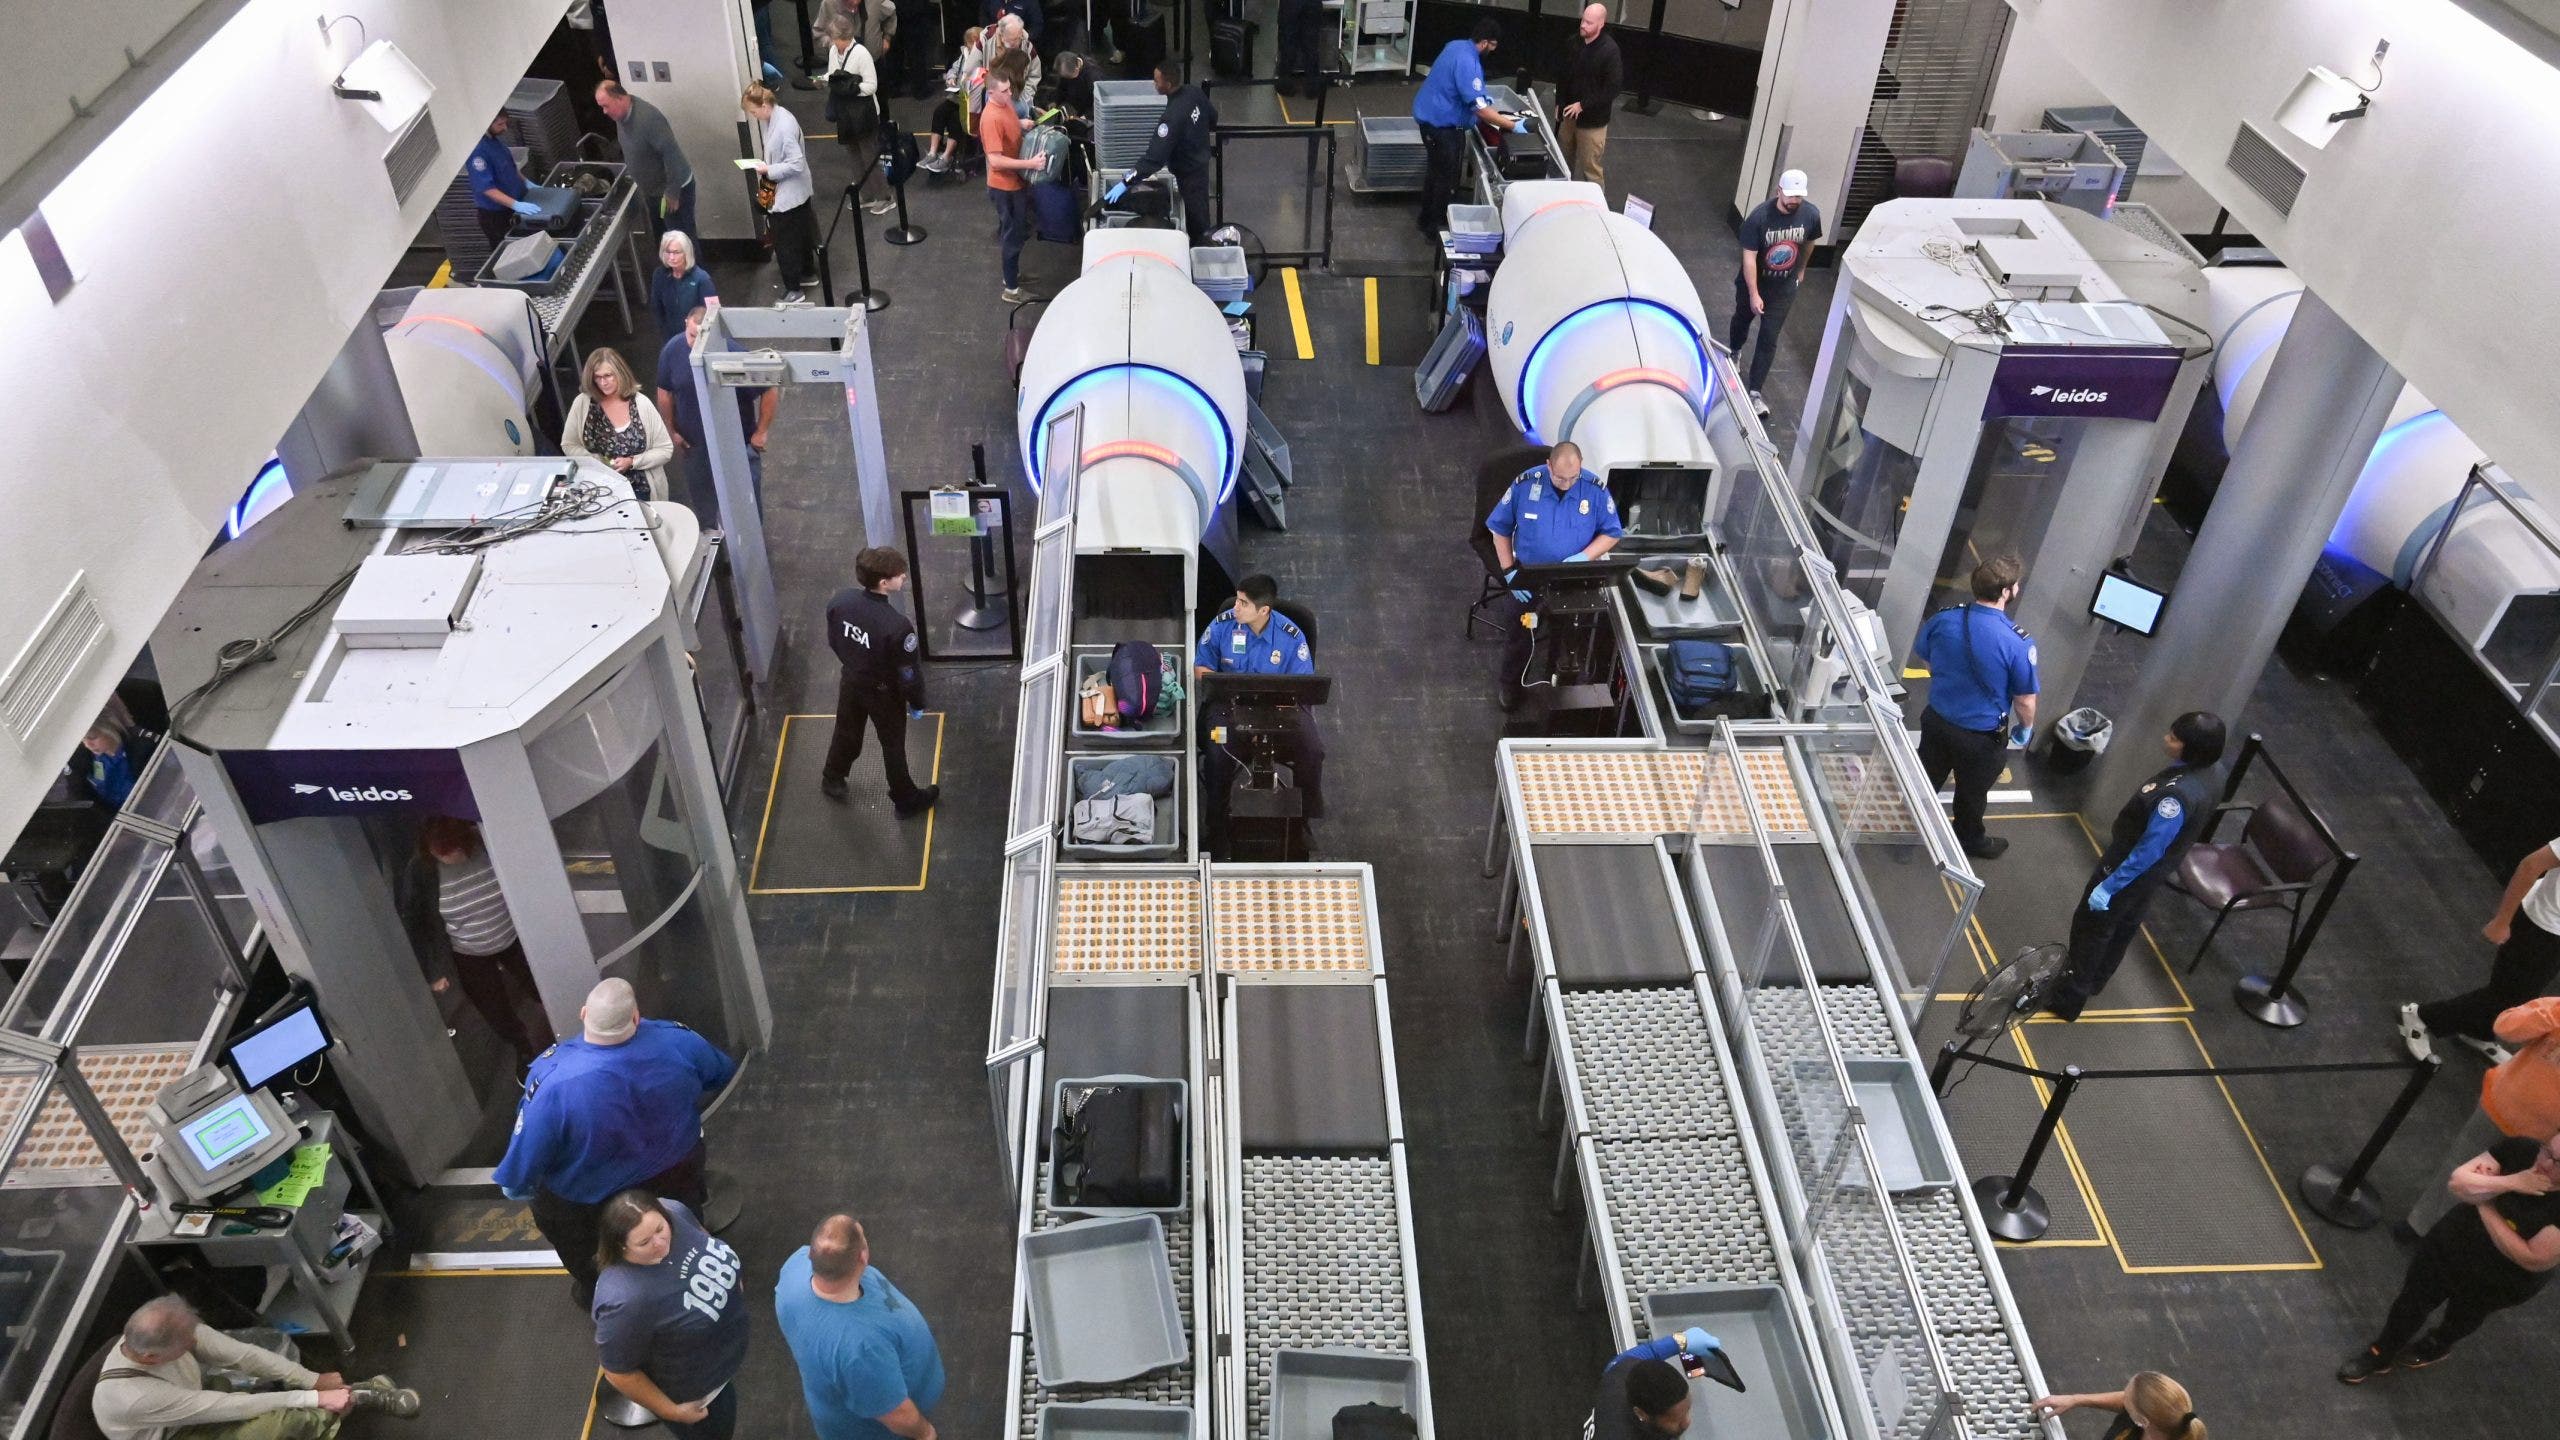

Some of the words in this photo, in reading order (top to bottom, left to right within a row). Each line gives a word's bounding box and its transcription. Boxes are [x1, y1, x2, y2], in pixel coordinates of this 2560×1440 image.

[2050, 388, 2109, 403] leidos
[842, 620, 871, 649] TSA
[327, 786, 413, 802] leidos
[680, 1246, 700, 1280] VINTAGE
[683, 1237, 742, 1323] 1985
